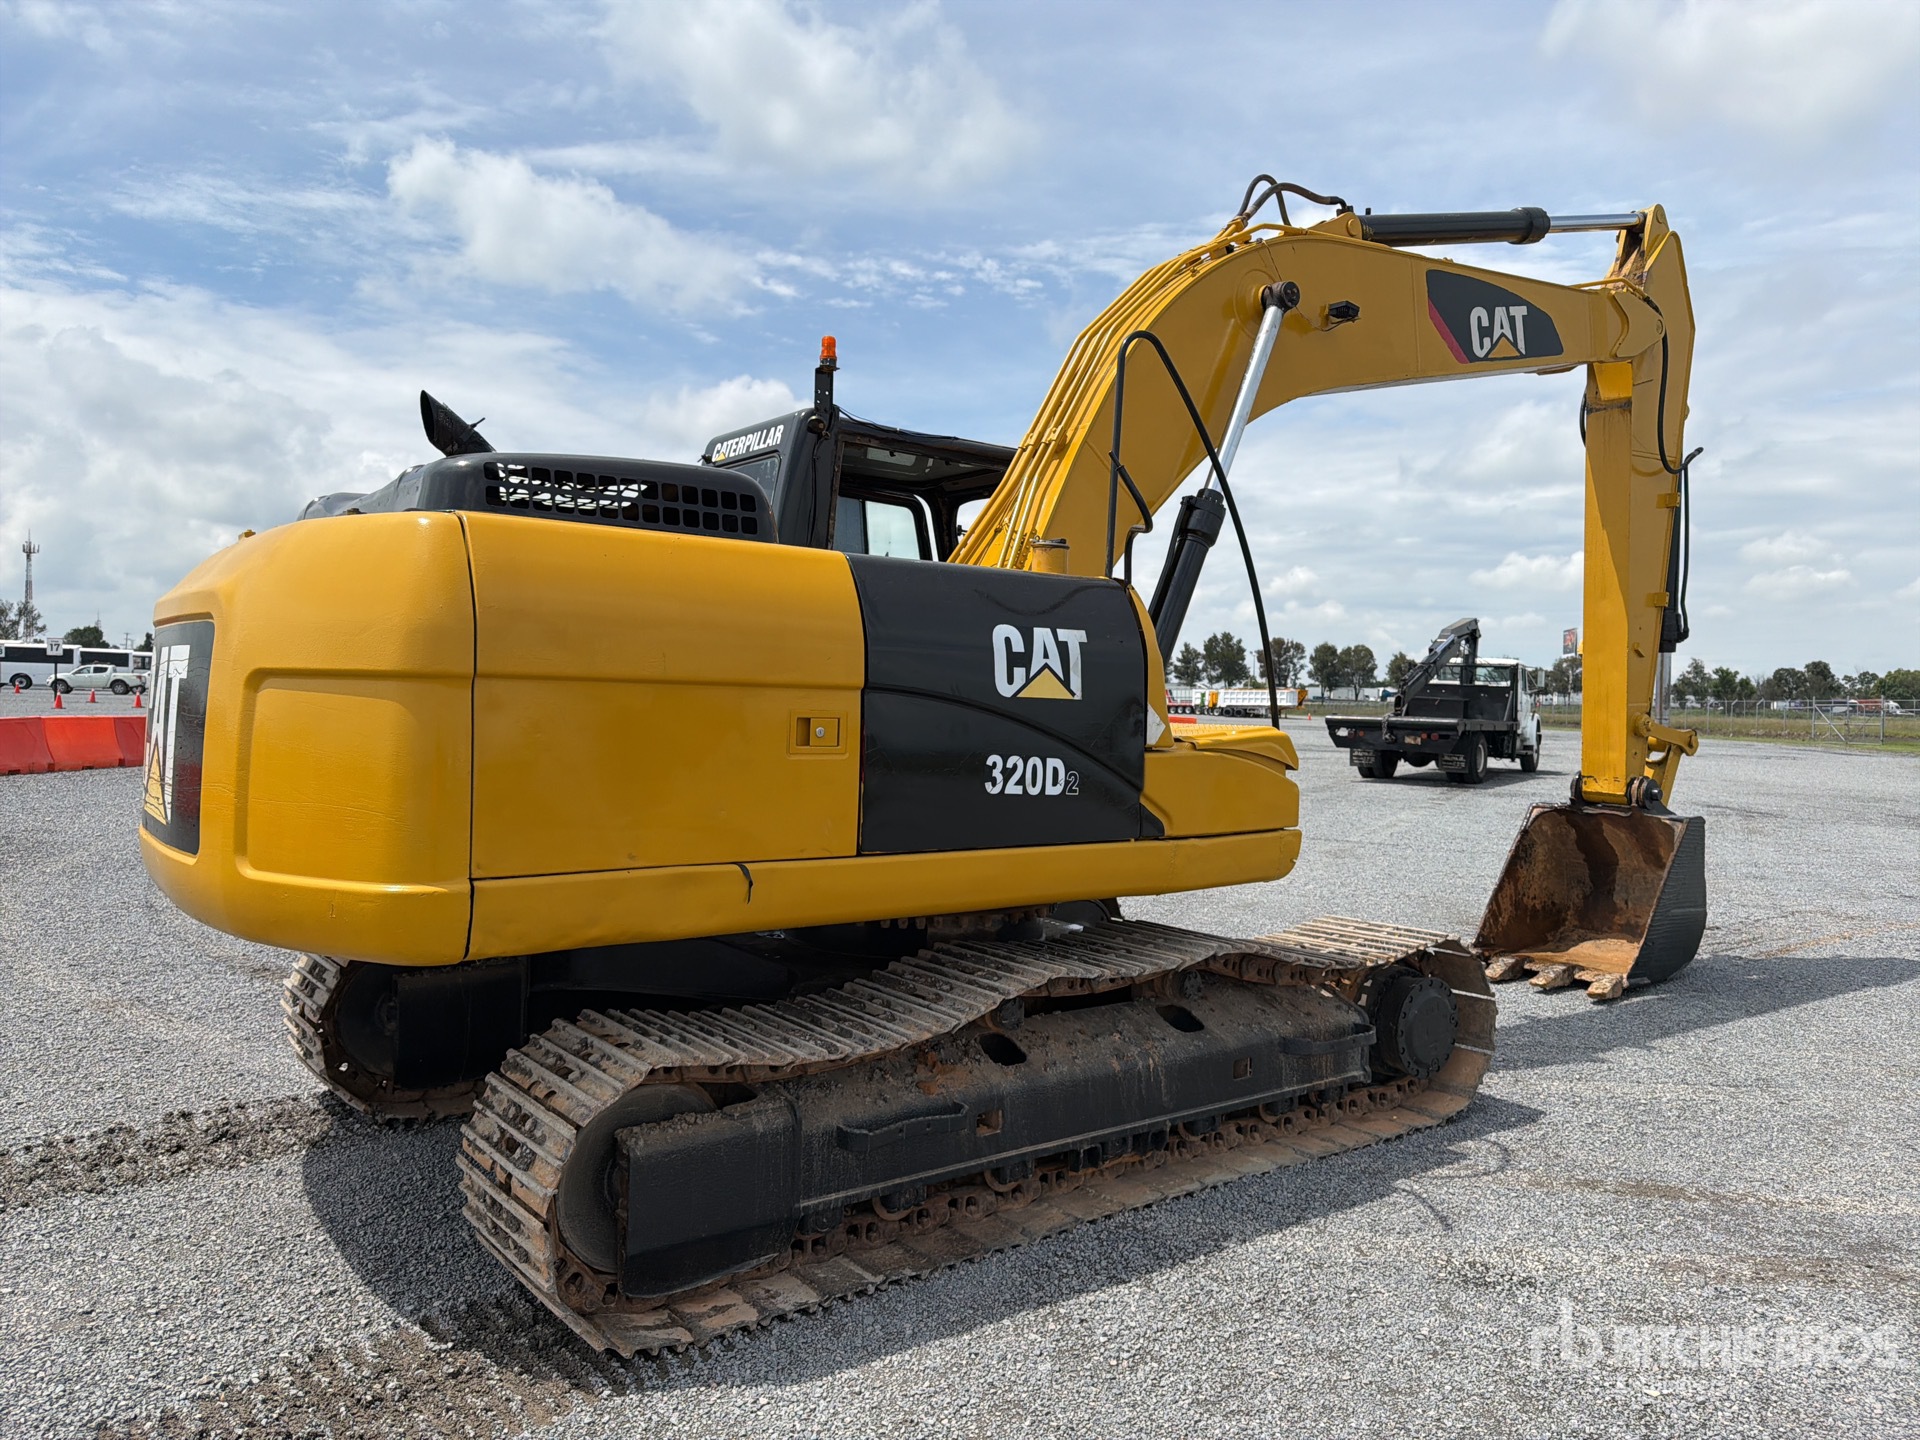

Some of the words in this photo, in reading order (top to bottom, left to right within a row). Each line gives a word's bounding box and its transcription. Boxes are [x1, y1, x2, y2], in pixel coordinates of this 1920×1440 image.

[1469, 305, 1528, 358] CAT
[711, 424, 784, 463] CATERPILLAR
[49, 643, 61, 652] 17
[992, 623, 1088, 700] CAT
